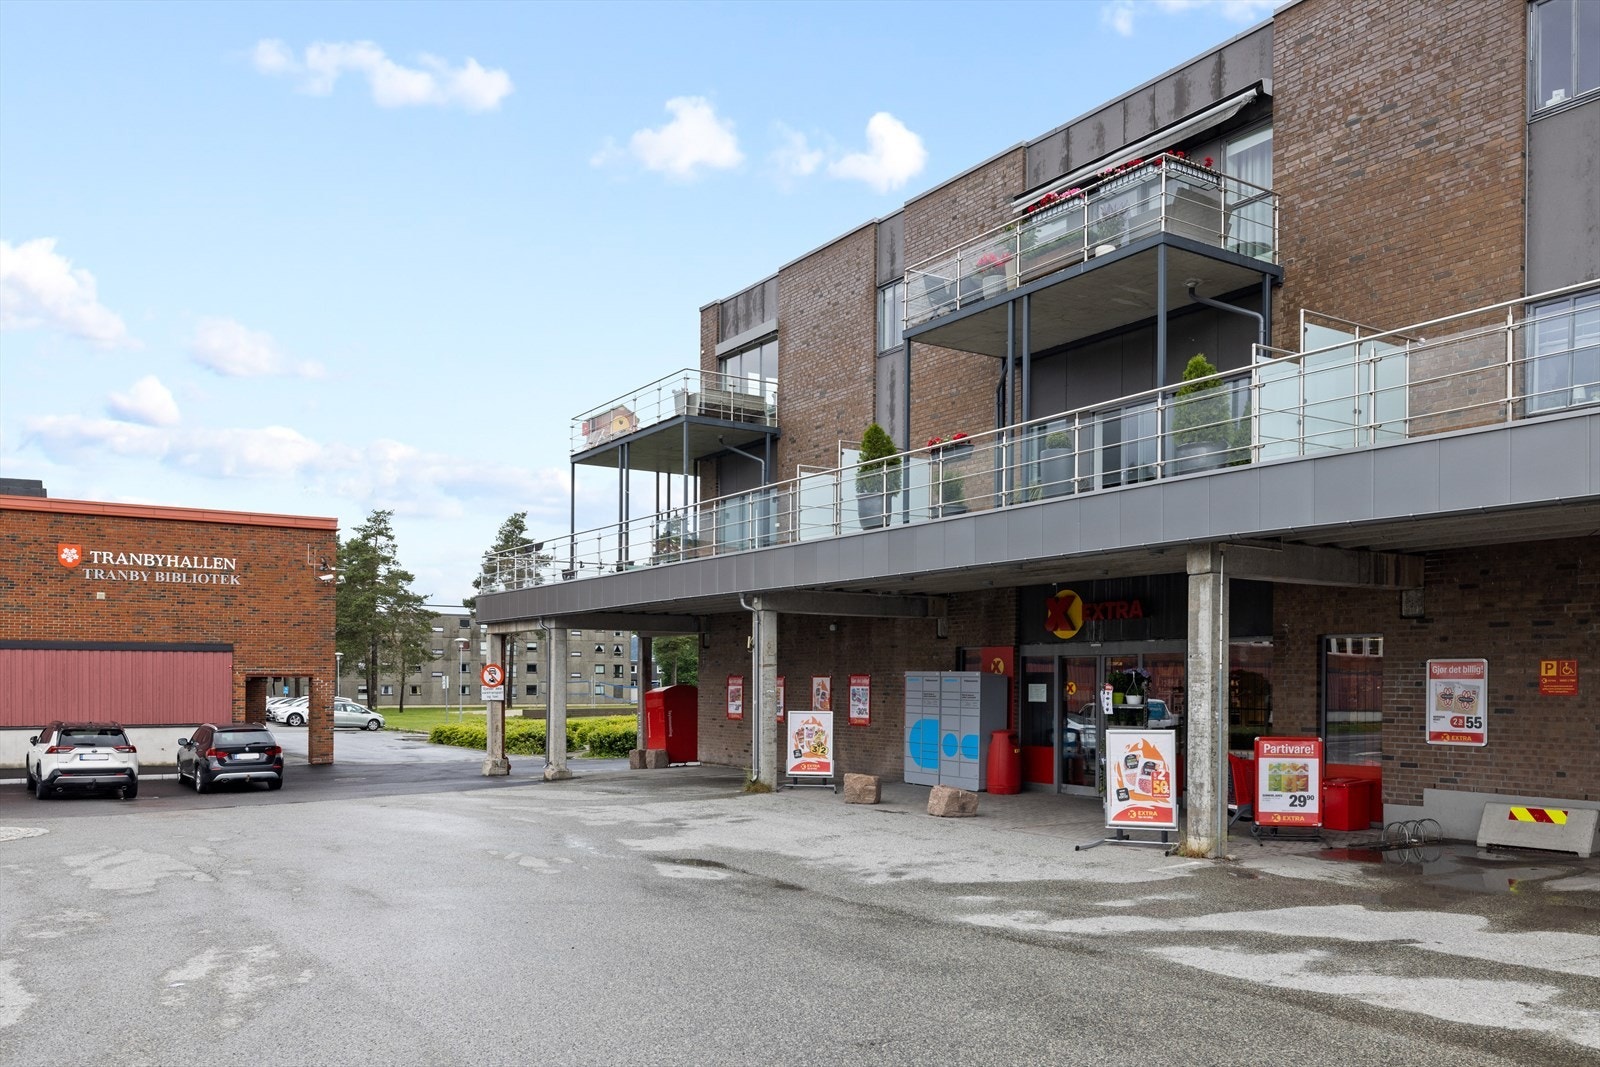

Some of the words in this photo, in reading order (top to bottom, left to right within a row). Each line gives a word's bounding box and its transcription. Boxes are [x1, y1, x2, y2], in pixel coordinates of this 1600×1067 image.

[89, 550, 237, 570] TRANBYHALLEN
[82, 568, 151, 582] TRANBY
[155, 571, 241, 585] BIBLIOTEK
[1083, 598, 1143, 621] EXTRA
[1449, 665, 1461, 674] det
[1462, 665, 1484, 675] billig!
[1545, 662, 1554, 675] P
[1453, 717, 1457, 726] 2
[1466, 716, 1482, 729] 55
[821, 746, 828, 755] 2
[1263, 743, 1314, 754] Partivare!
[1157, 769, 1166, 781] 2
[1289, 794, 1307, 808] 29
